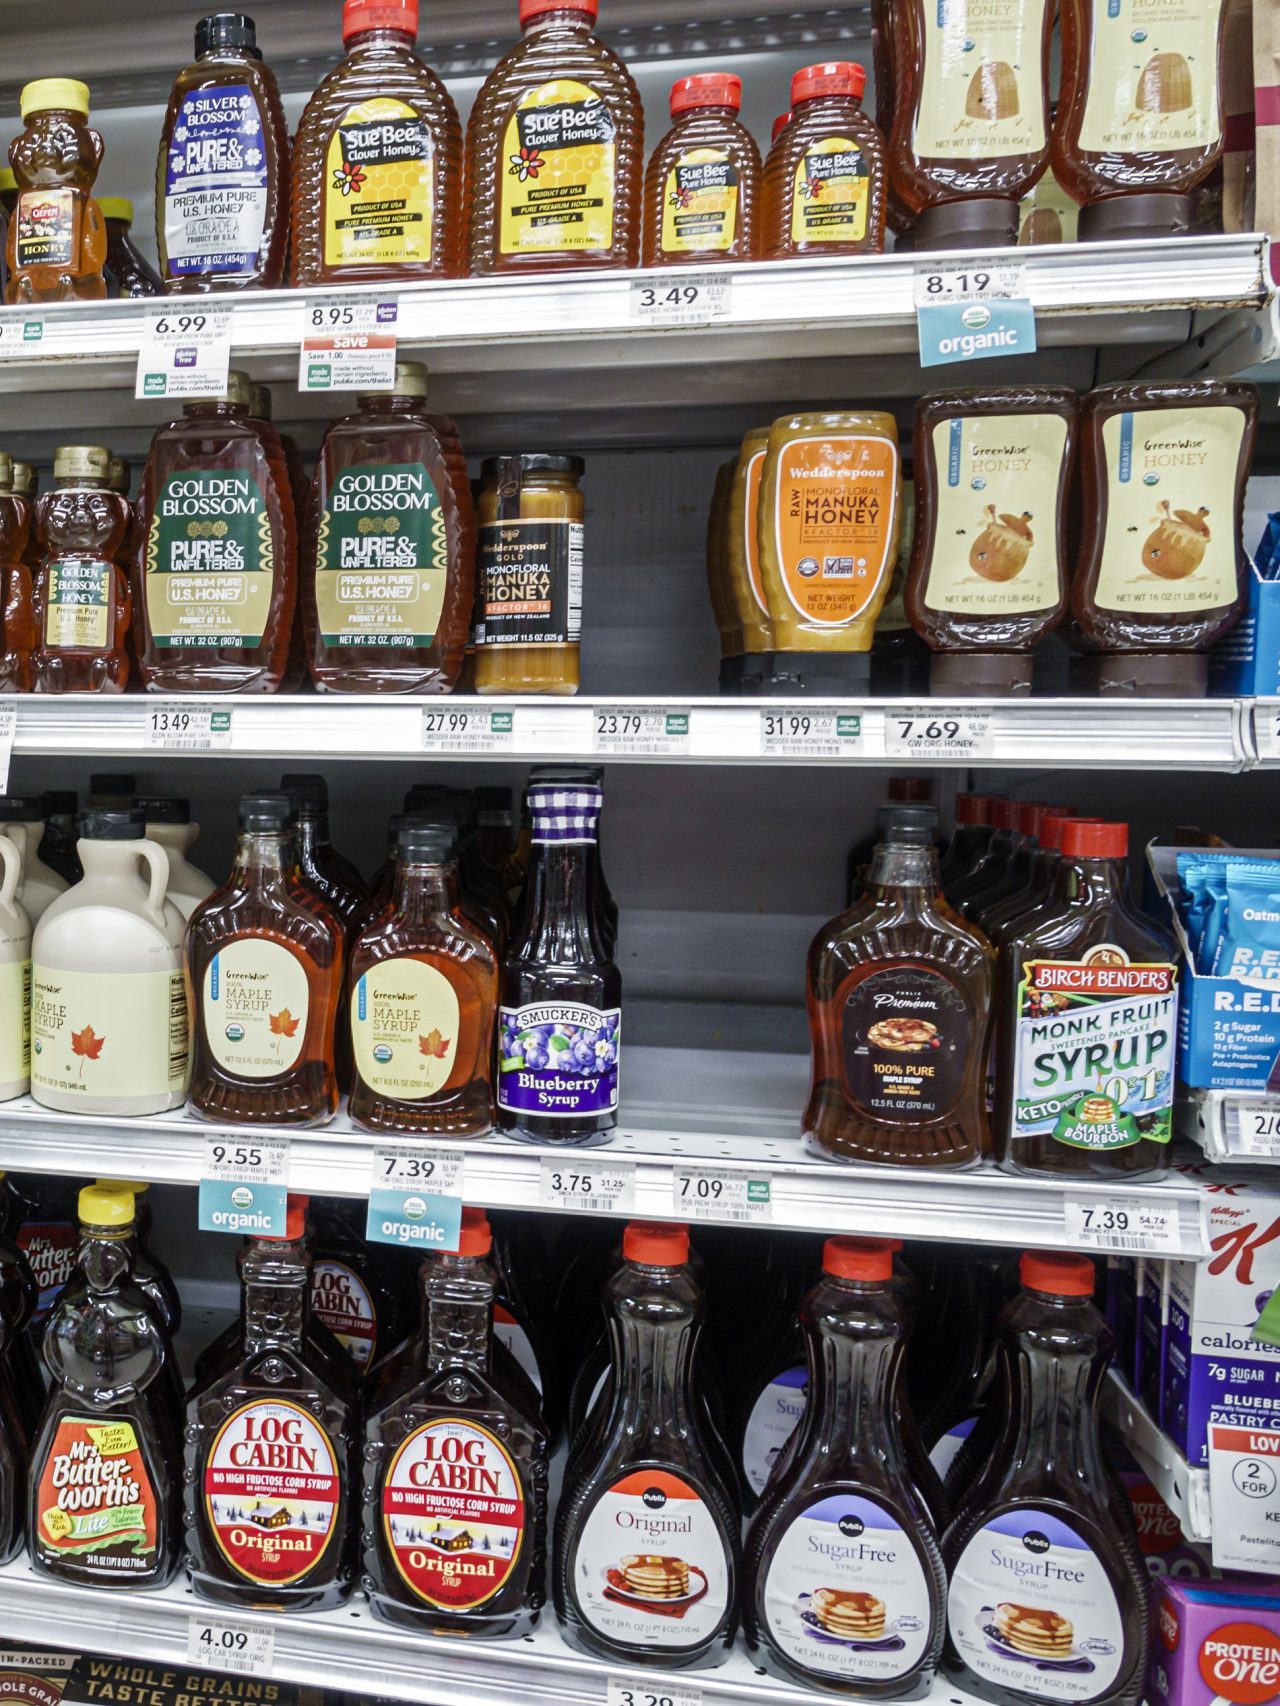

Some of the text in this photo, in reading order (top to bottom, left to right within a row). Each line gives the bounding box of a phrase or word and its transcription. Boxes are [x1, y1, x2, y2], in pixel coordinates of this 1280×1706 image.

[195, 97, 238, 112] SILVER
[188, 111, 245, 126] BLOSSOM
[524, 108, 596, 134] Sue Bee
[525, 129, 597, 146] Clover Honey
[186, 161, 243, 174] UNFILTERED
[809, 155, 856, 169] Sue Bee
[811, 167, 857, 179] Pure Honey
[173, 192, 257, 208] PREMIUM PURE
[183, 204, 244, 217] U.S. HONEY
[24, 243, 65, 255] HONEY
[926, 273, 991, 294] 8.19
[640, 286, 699, 307] 3.49
[156, 316, 207, 334] 6.99
[312, 308, 354, 326] 8.95
[333, 335, 368, 350] save
[939, 327, 1018, 356] organic
[175, 349, 196, 359] gluten
[179, 356, 194, 364] free
[1144, 452, 1207, 467] HONEY
[789, 466, 886, 479] Wedderspoon
[339, 474, 422, 492] GOLDEN
[806, 486, 880, 498] MONOFLORAL
[333, 492, 429, 512] BLOSSOM
[790, 490, 801, 517] RAW
[806, 497, 879, 510] MANUKA
[805, 508, 879, 524] HONEY
[341, 556, 417, 569] UNFILTERED
[497, 553, 524, 562] GOLD
[486, 564, 550, 574] MONOFLORAL
[341, 574, 414, 586] PREMIUM PURE
[488, 574, 549, 586] MANUKA
[341, 586, 414, 599] U.S. HONEY
[486, 585, 550, 601] HONEY
[152, 714, 189, 731] 13.49
[426, 714, 468, 731] 27.99
[598, 716, 641, 733] 23.79
[764, 717, 812, 735] 31.99
[898, 720, 960, 739] 7.69
[1036, 967, 1168, 989] BIRCH BENDERS
[373, 991, 416, 1000] GreenWise
[874, 994, 938, 1011] Premium
[373, 1008, 421, 1020] MAPLE
[521, 1010, 598, 1028] SMUCKER'S
[1031, 999, 1172, 1044] MONK FRUIT
[373, 1020, 418, 1032] SYRUP
[1214, 1022, 1221, 1030] 2
[1231, 1022, 1261, 1033] Sugar
[1051, 1024, 1151, 1051] SWEETENED PANCAKE
[1215, 1033, 1275, 1044] 10 g Protein
[1033, 1029, 1168, 1087] SYRUP
[873, 1064, 935, 1077] 100% PURE
[518, 1073, 600, 1093] Blueberry
[538, 1092, 580, 1108] Syrup
[1018, 1100, 1062, 1121] KETO
[1065, 1127, 1129, 1143] BOURBON
[1076, 1121, 1119, 1135] MAPLE
[212, 1147, 262, 1166] 9.55
[383, 1158, 435, 1178] 7.39
[552, 1174, 592, 1192] 3.75
[679, 1178, 723, 1198] 7.09
[212, 1211, 271, 1229] organic
[1083, 1209, 1129, 1230] 7.39
[381, 1222, 444, 1242] organic
[244, 1417, 304, 1445] LOG
[229, 1444, 318, 1472] CABIN
[213, 1472, 332, 1489] NO HIGH FRUCTOSE CORN SYRUP
[616, 1510, 693, 1535] Original
[230, 1529, 312, 1554] Original
[200, 1628, 248, 1651] 4.09
